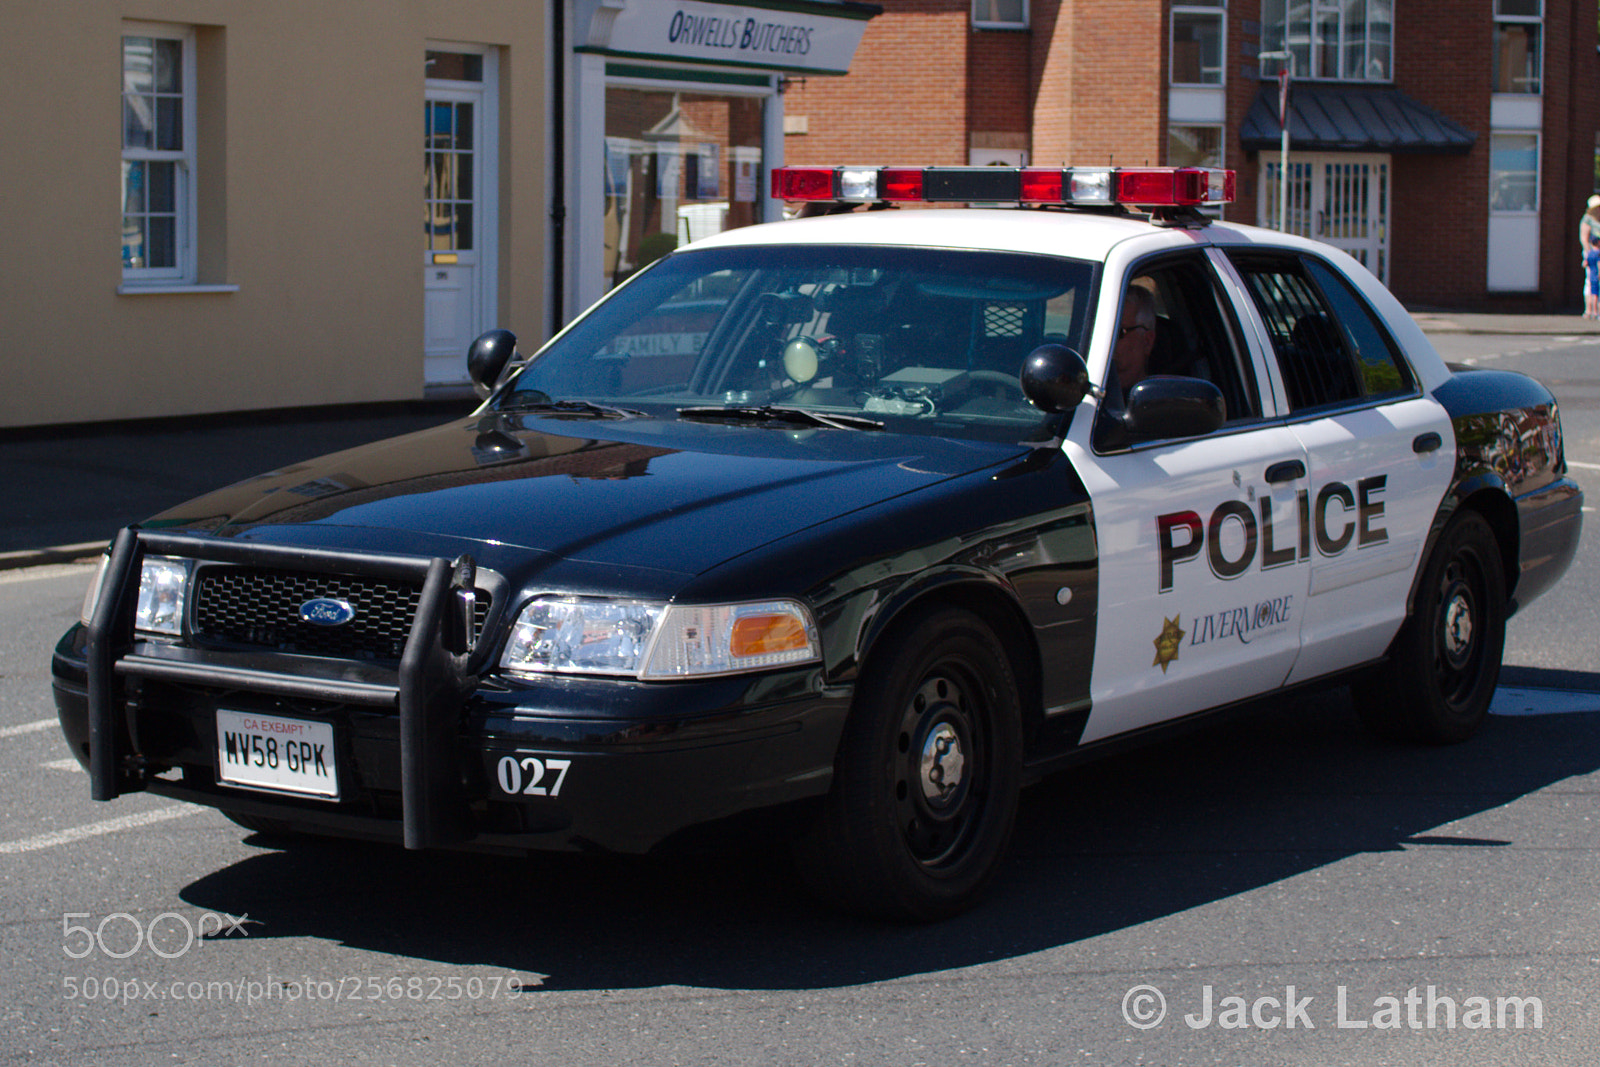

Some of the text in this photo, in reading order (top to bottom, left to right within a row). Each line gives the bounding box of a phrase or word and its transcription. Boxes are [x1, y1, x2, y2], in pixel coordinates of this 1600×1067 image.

[668, 10, 814, 55] ORWELLS BUTCHERS
[1155, 474, 1389, 595] POLICE
[1190, 595, 1293, 645] LIVERMORE
[244, 719, 304, 735] CA EXEMPT
[225, 731, 328, 777] MV58 GPK
[497, 756, 572, 797] 027
